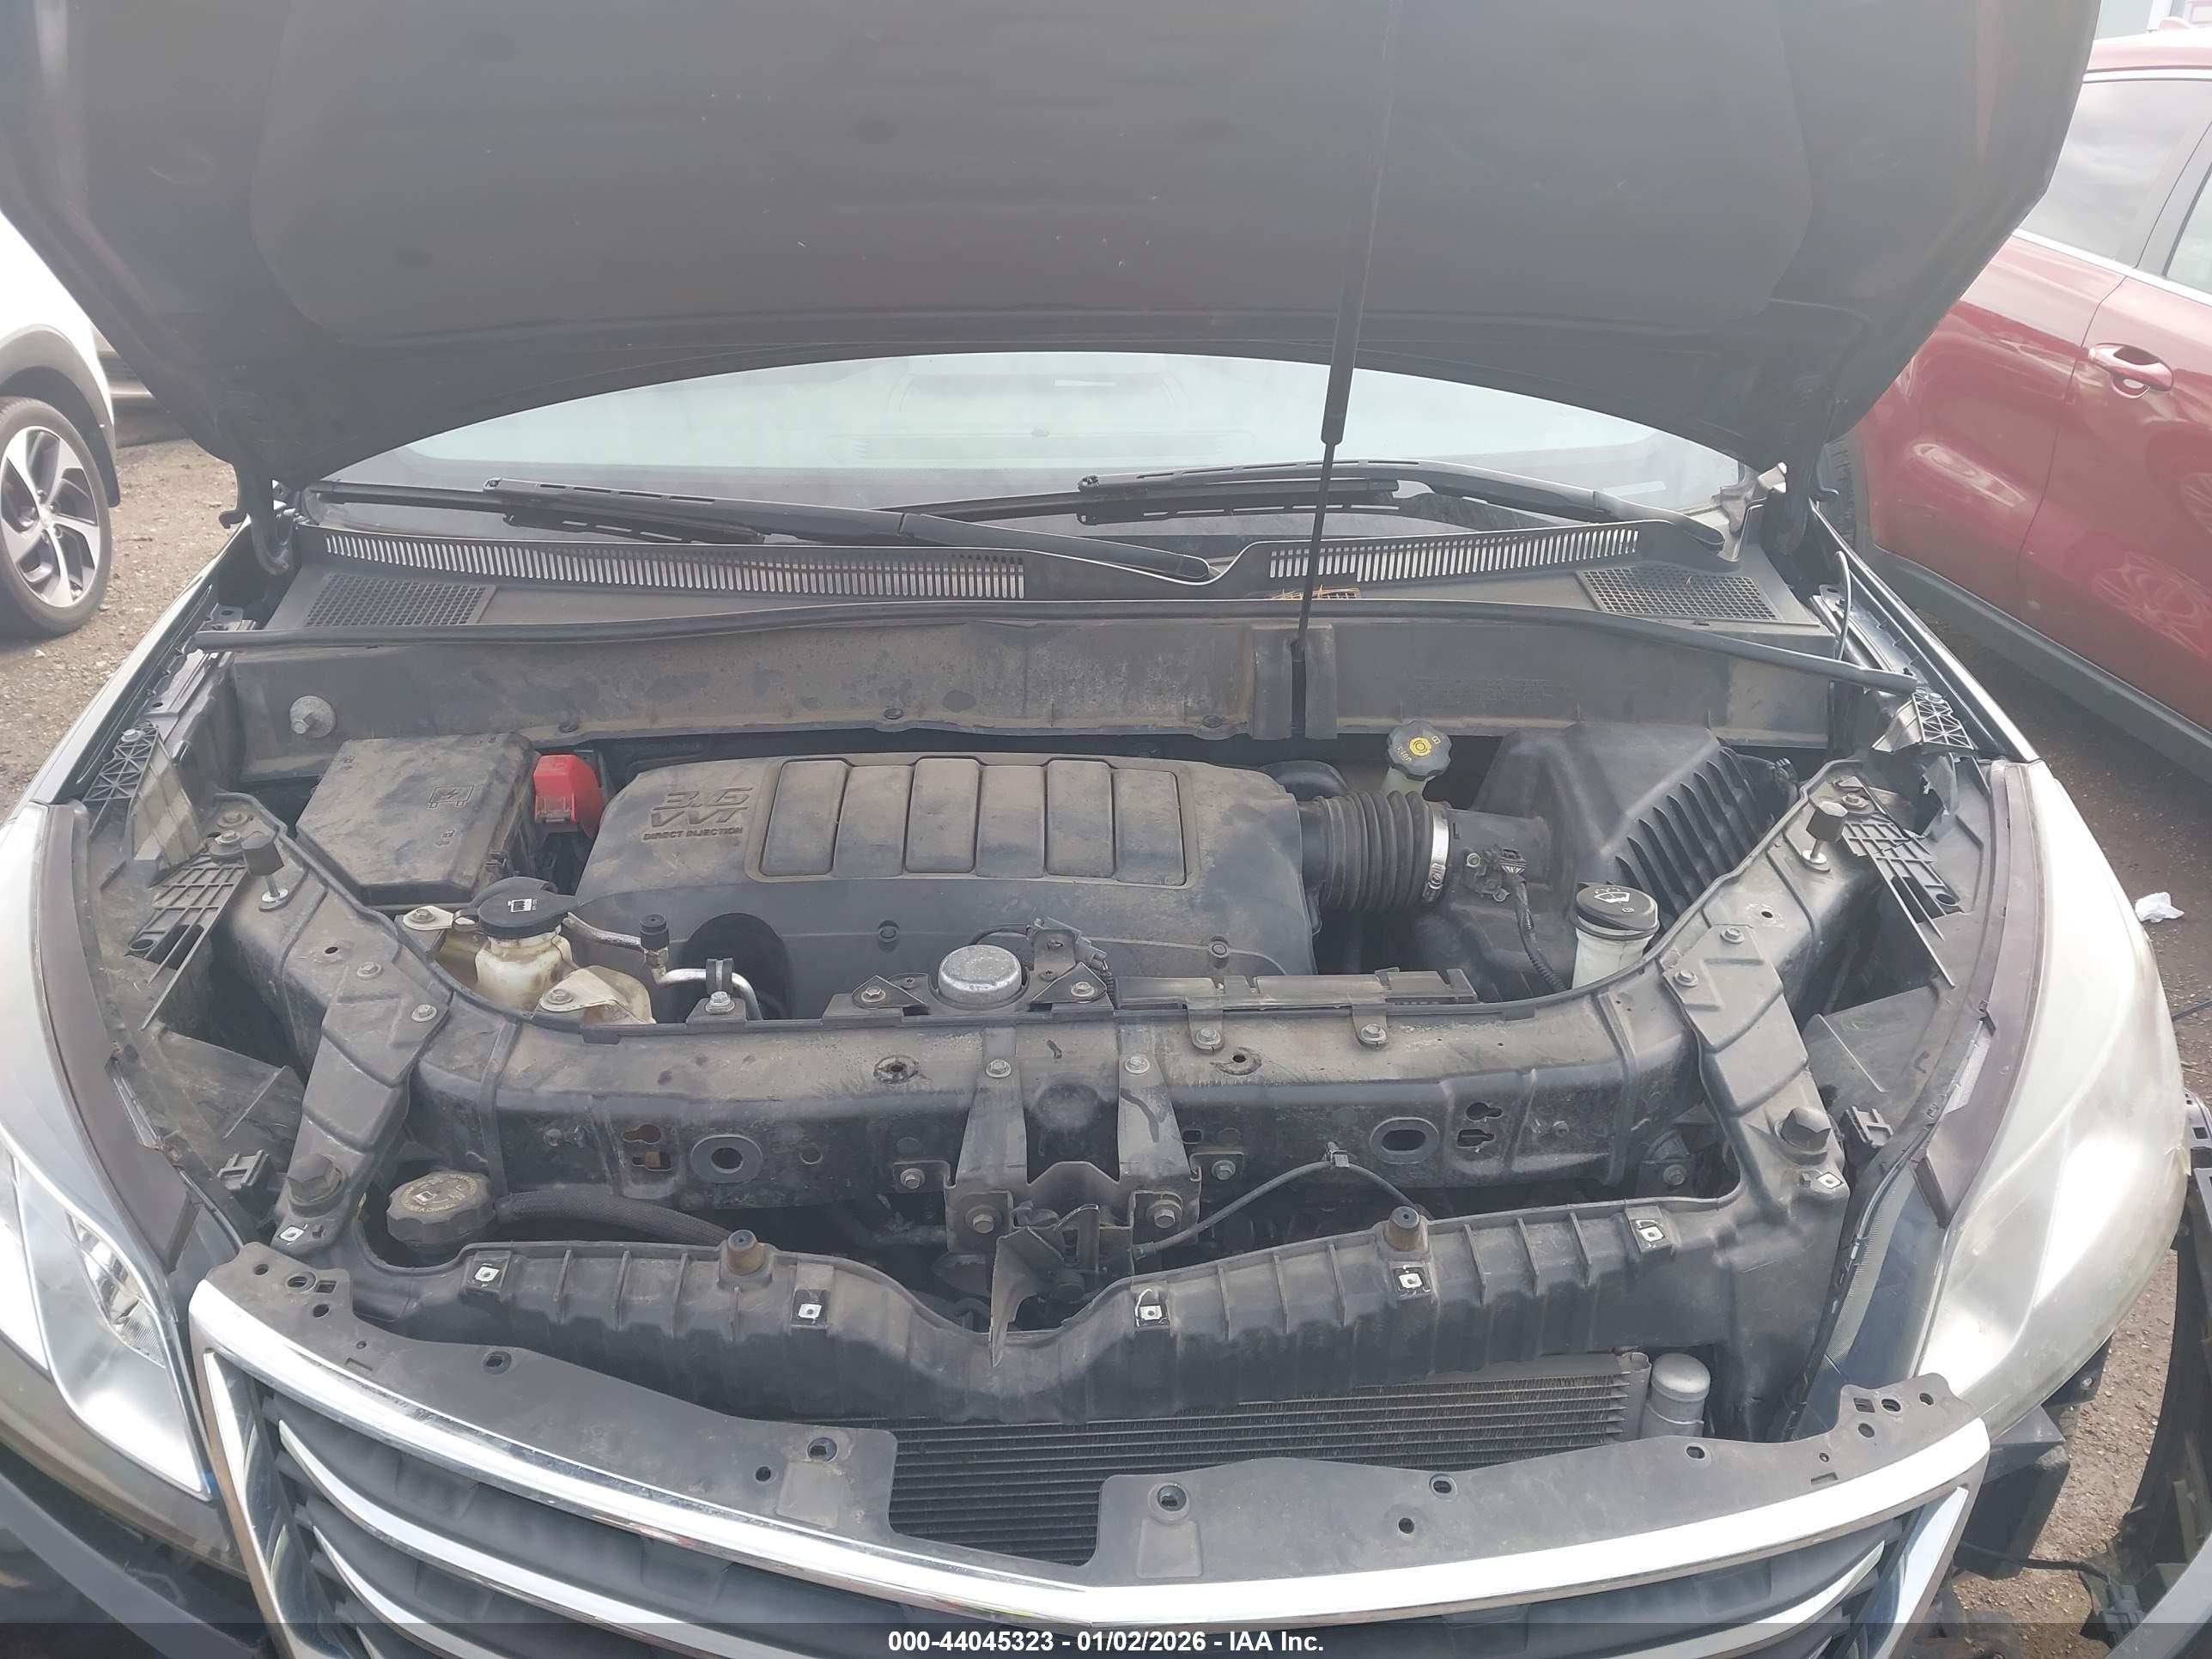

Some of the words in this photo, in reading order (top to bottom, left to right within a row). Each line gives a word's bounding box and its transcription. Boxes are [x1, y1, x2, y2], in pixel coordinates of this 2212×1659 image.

[652, 787, 754, 811] 3.6
[650, 806, 749, 828] VVT
[642, 830, 684, 842] DIRECT
[686, 827, 743, 838] INJECTION
